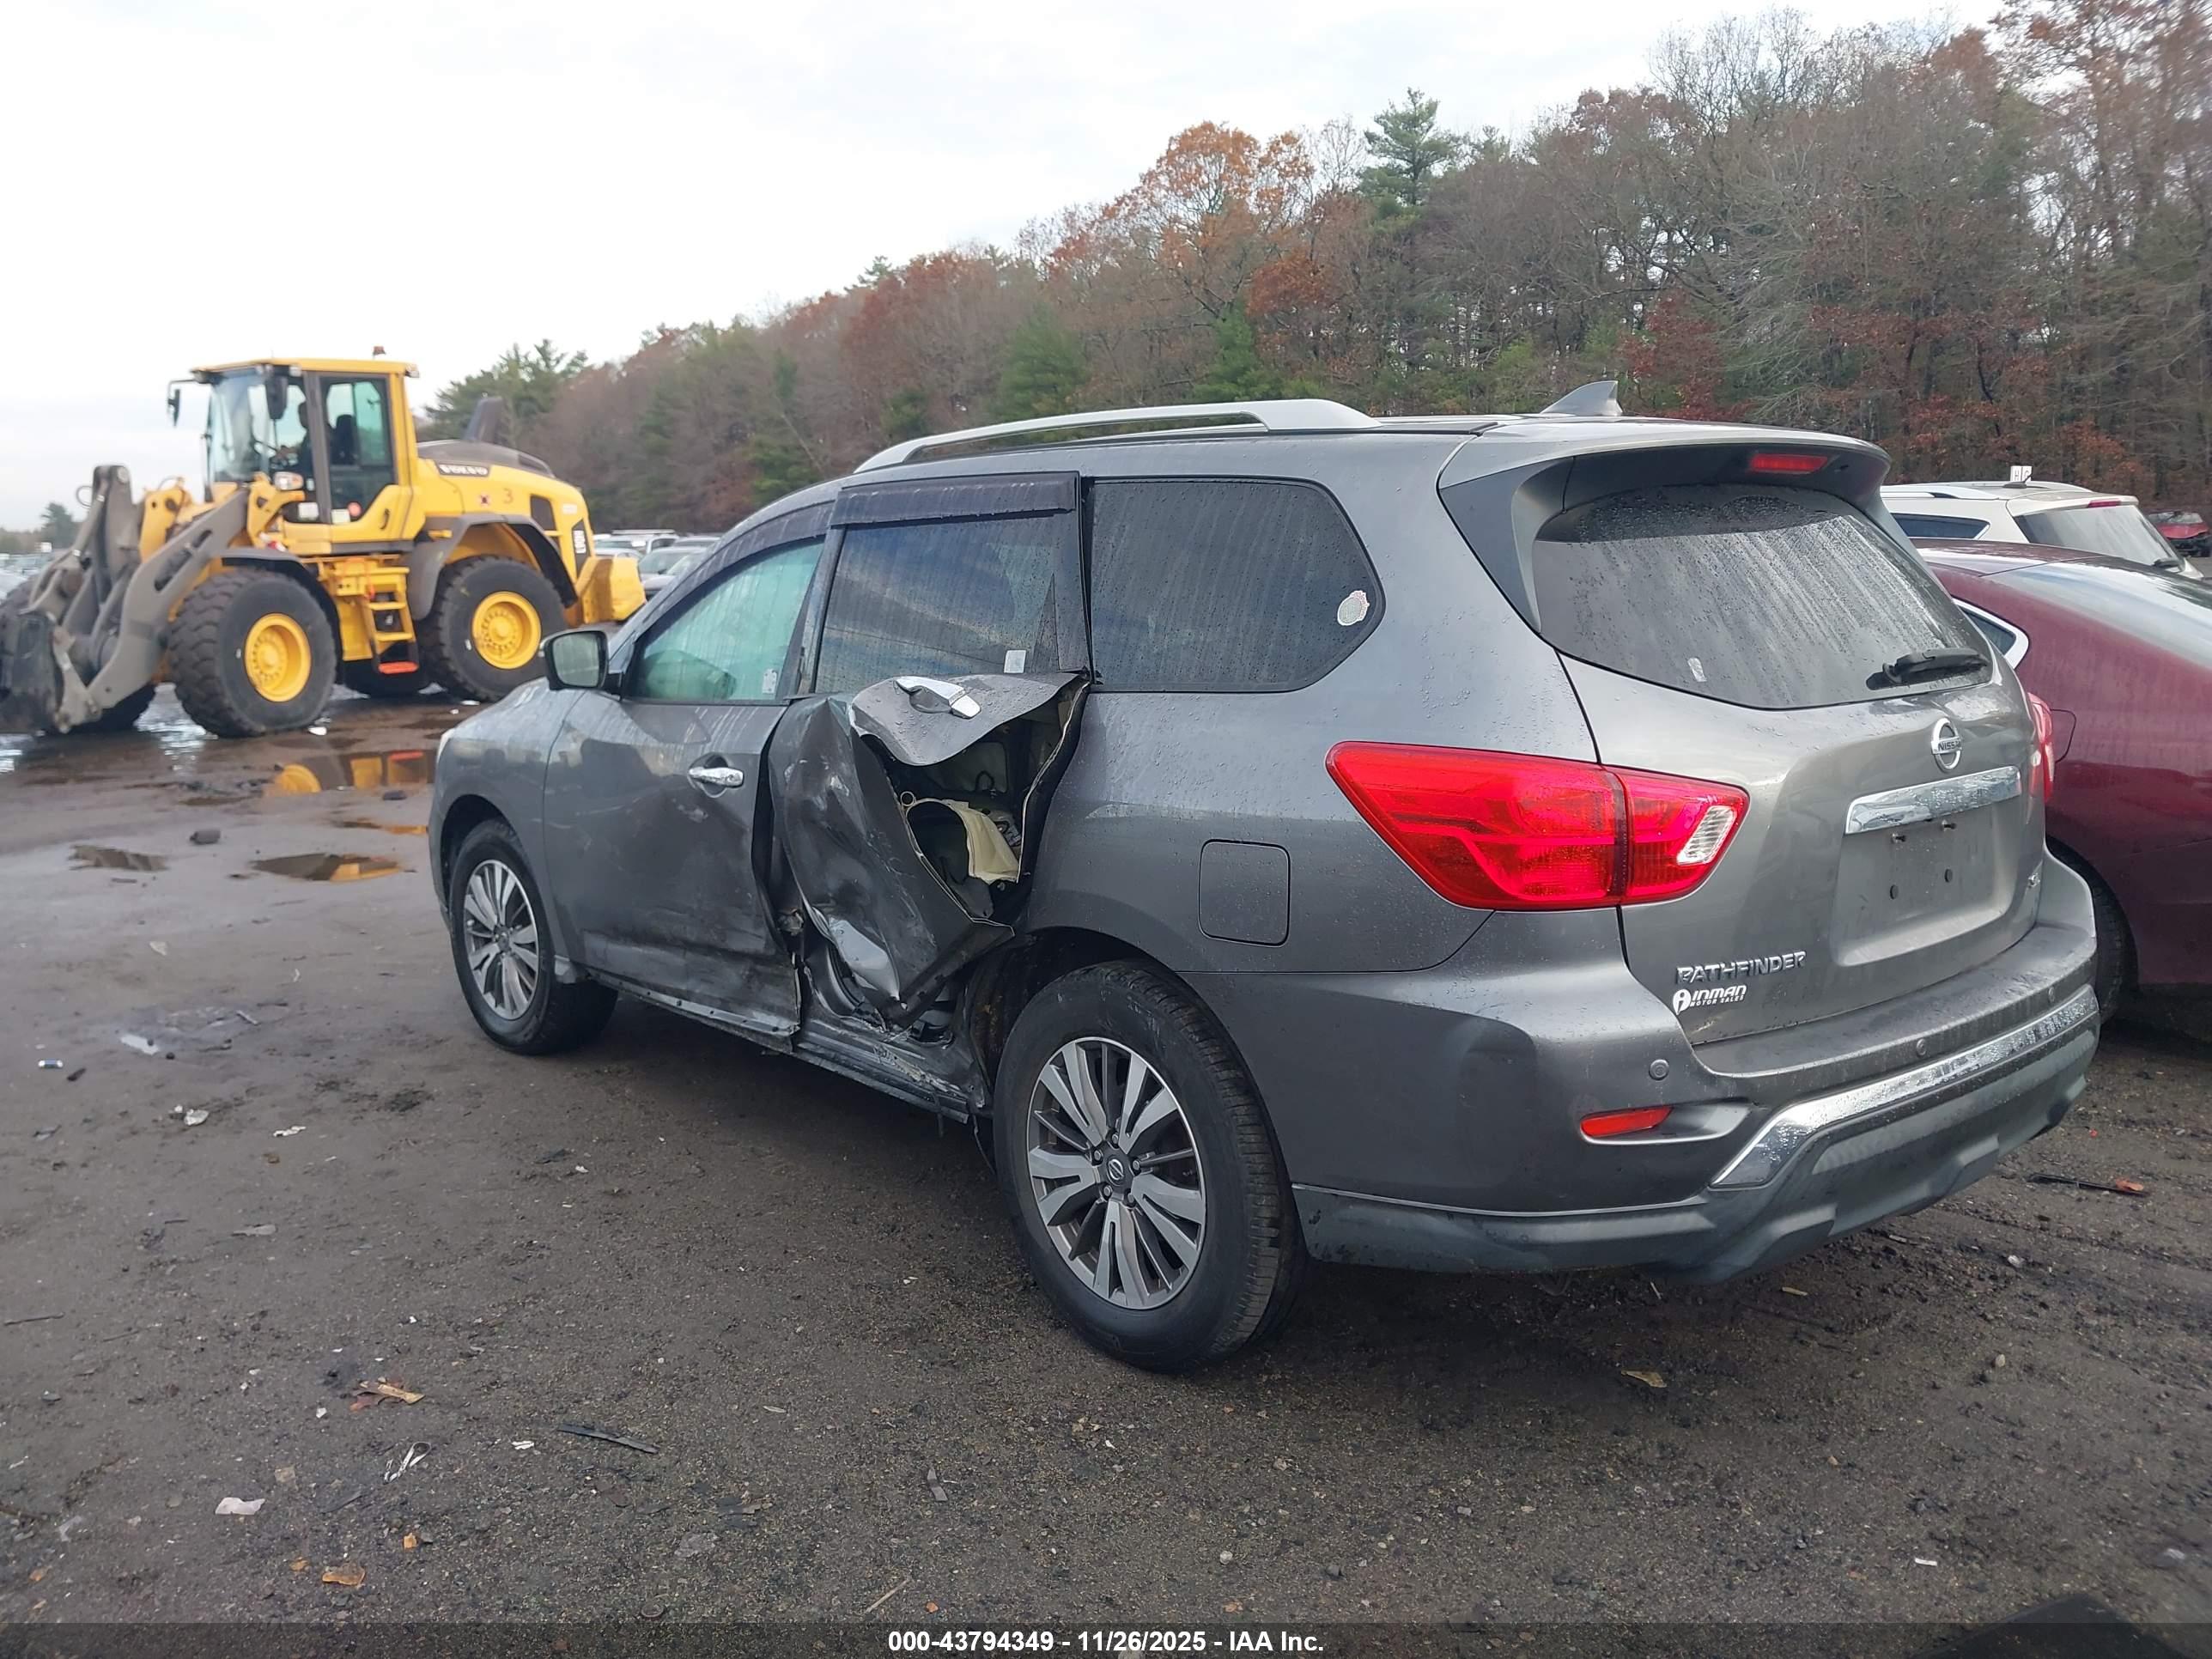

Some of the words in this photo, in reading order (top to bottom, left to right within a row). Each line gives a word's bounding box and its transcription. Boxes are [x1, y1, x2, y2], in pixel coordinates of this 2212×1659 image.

[1937, 739, 1961, 751] NISS
[1676, 951, 1807, 984] PATHFINDER
[1690, 999, 1717, 1007] MOTOR
[1720, 994, 1745, 1004] SALES
